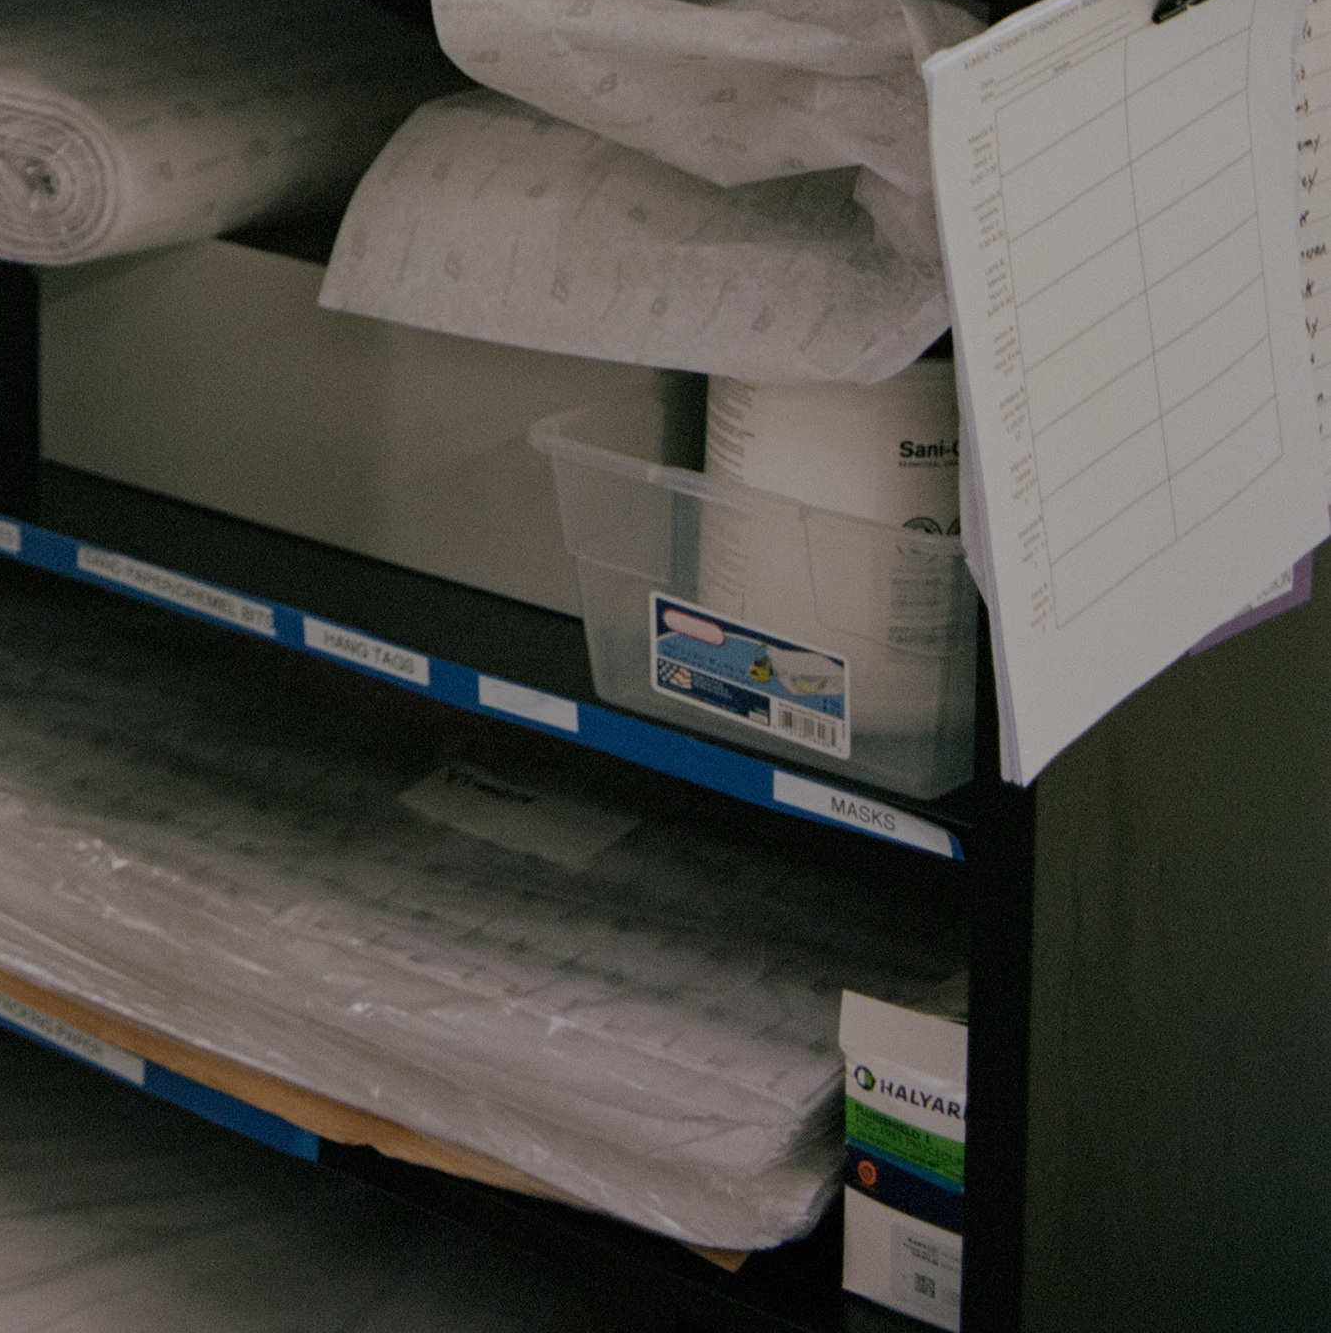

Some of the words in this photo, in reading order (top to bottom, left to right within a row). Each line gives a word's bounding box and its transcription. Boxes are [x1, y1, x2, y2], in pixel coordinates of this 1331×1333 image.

[323, 631, 368, 659] HANG
[831, 795, 896, 831] MASKS
[880, 1078, 966, 1120] HALYAR
